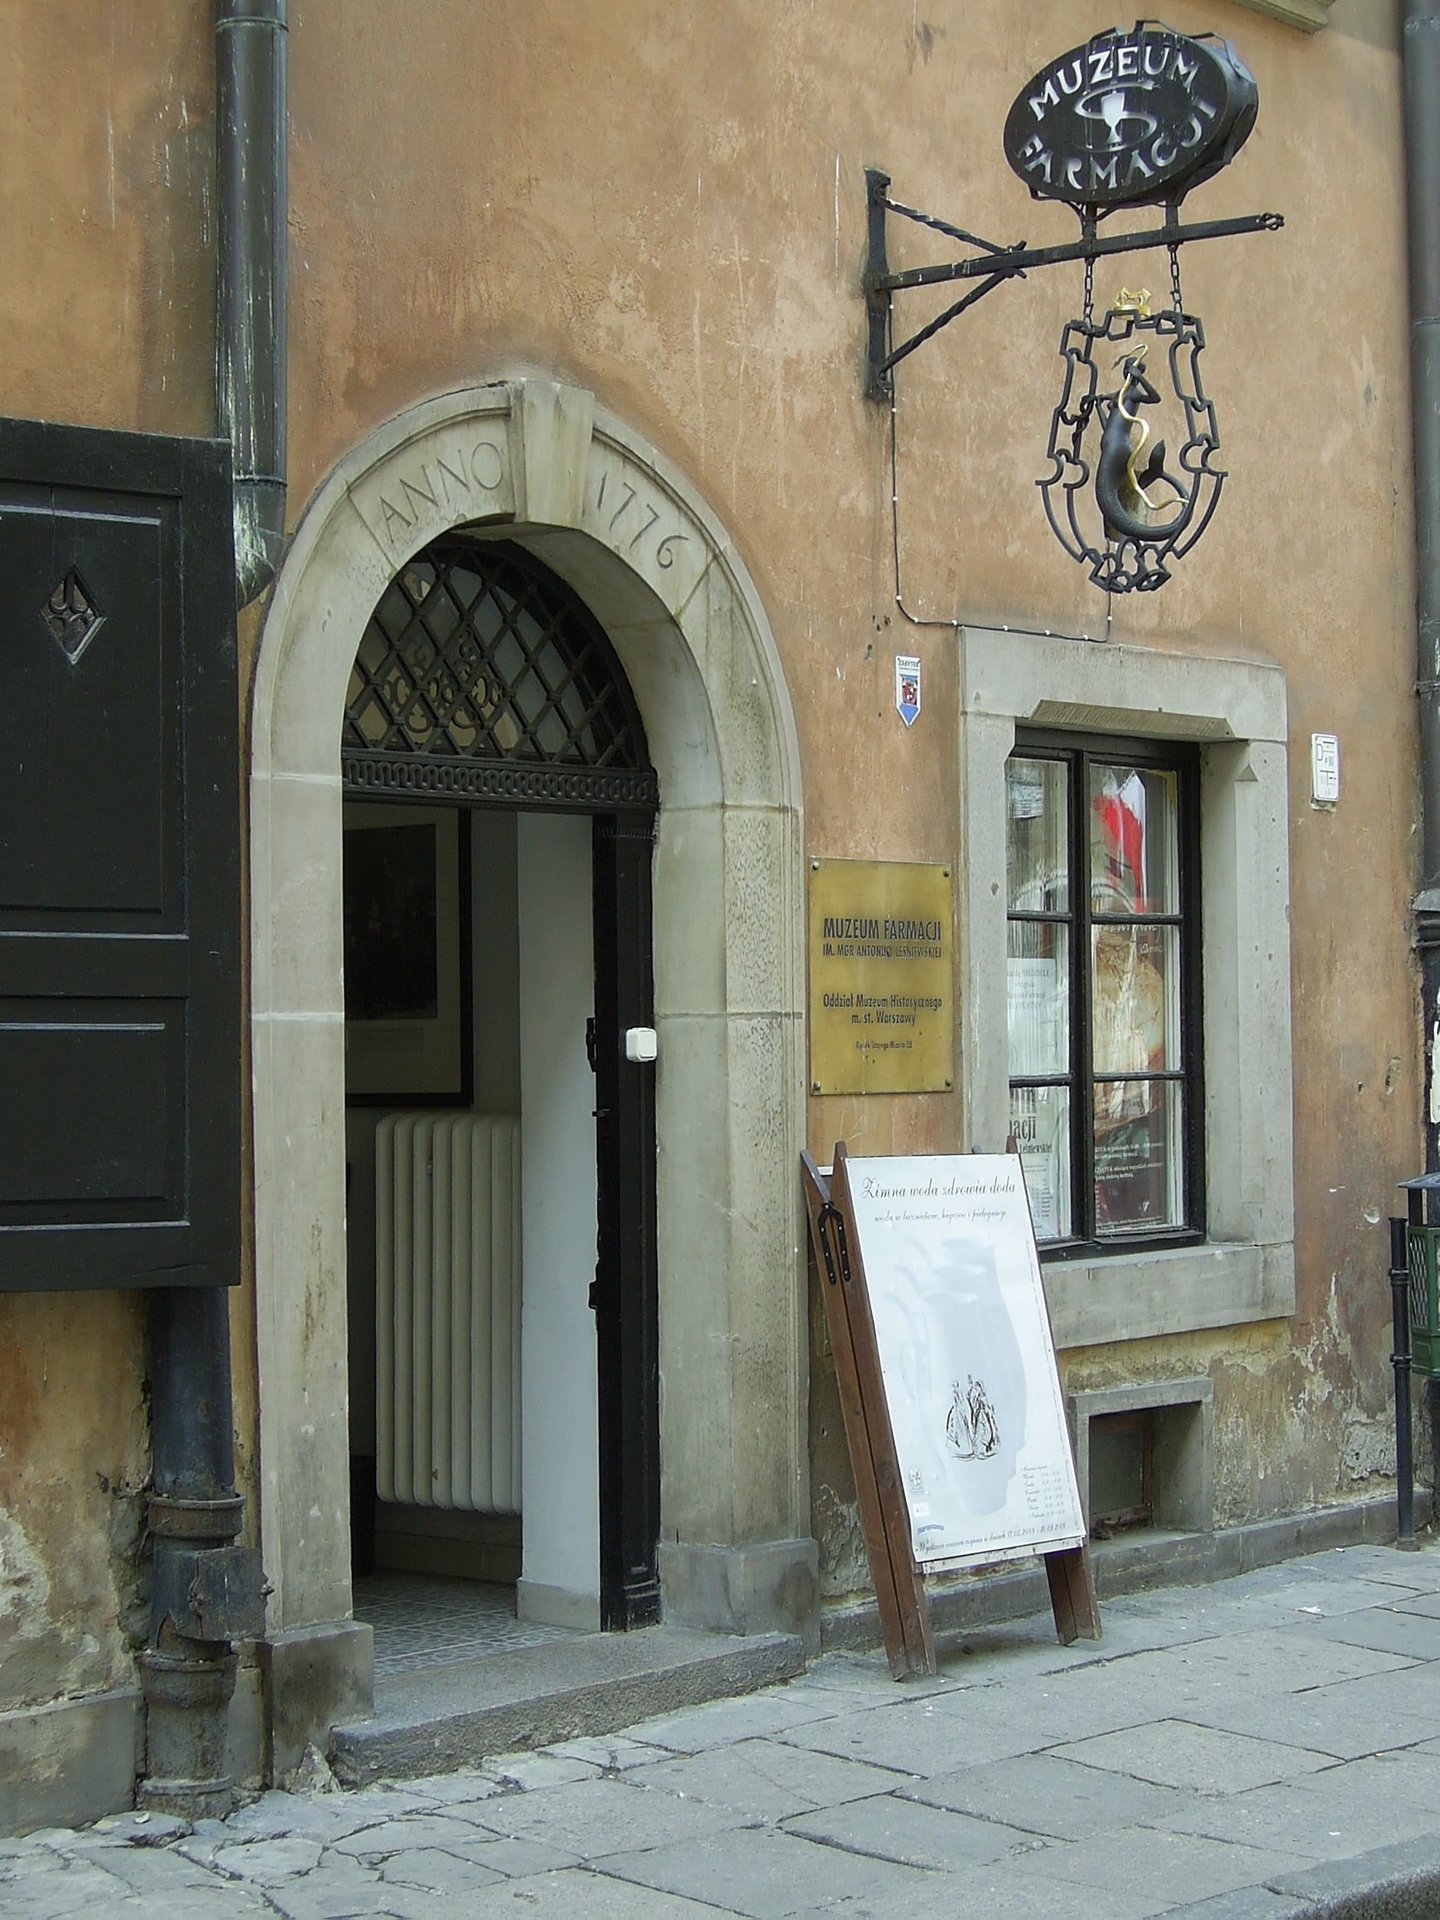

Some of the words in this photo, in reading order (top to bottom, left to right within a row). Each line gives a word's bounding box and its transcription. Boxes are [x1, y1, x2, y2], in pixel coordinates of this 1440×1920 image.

[1028, 45, 1202, 121] MUZEUM
[1015, 97, 1217, 190] FARMACJI
[379, 441, 504, 544] ANNO
[596, 471, 690, 569] 1776
[823, 918, 879, 938] MUZEUM
[884, 920, 941, 940] FARMACJI
[823, 944, 835, 956] IM.
[857, 994, 888, 1008] Muzeum
[891, 994, 943, 1012] Historycznego
[851, 1014, 862, 1024] m.
[864, 1012, 874, 1024] st.
[877, 1010, 916, 1027] Warszawy
[862, 1177, 905, 1198] Zimna
[910, 1178, 938, 1196] woda
[942, 1177, 986, 1196] zdrowia
